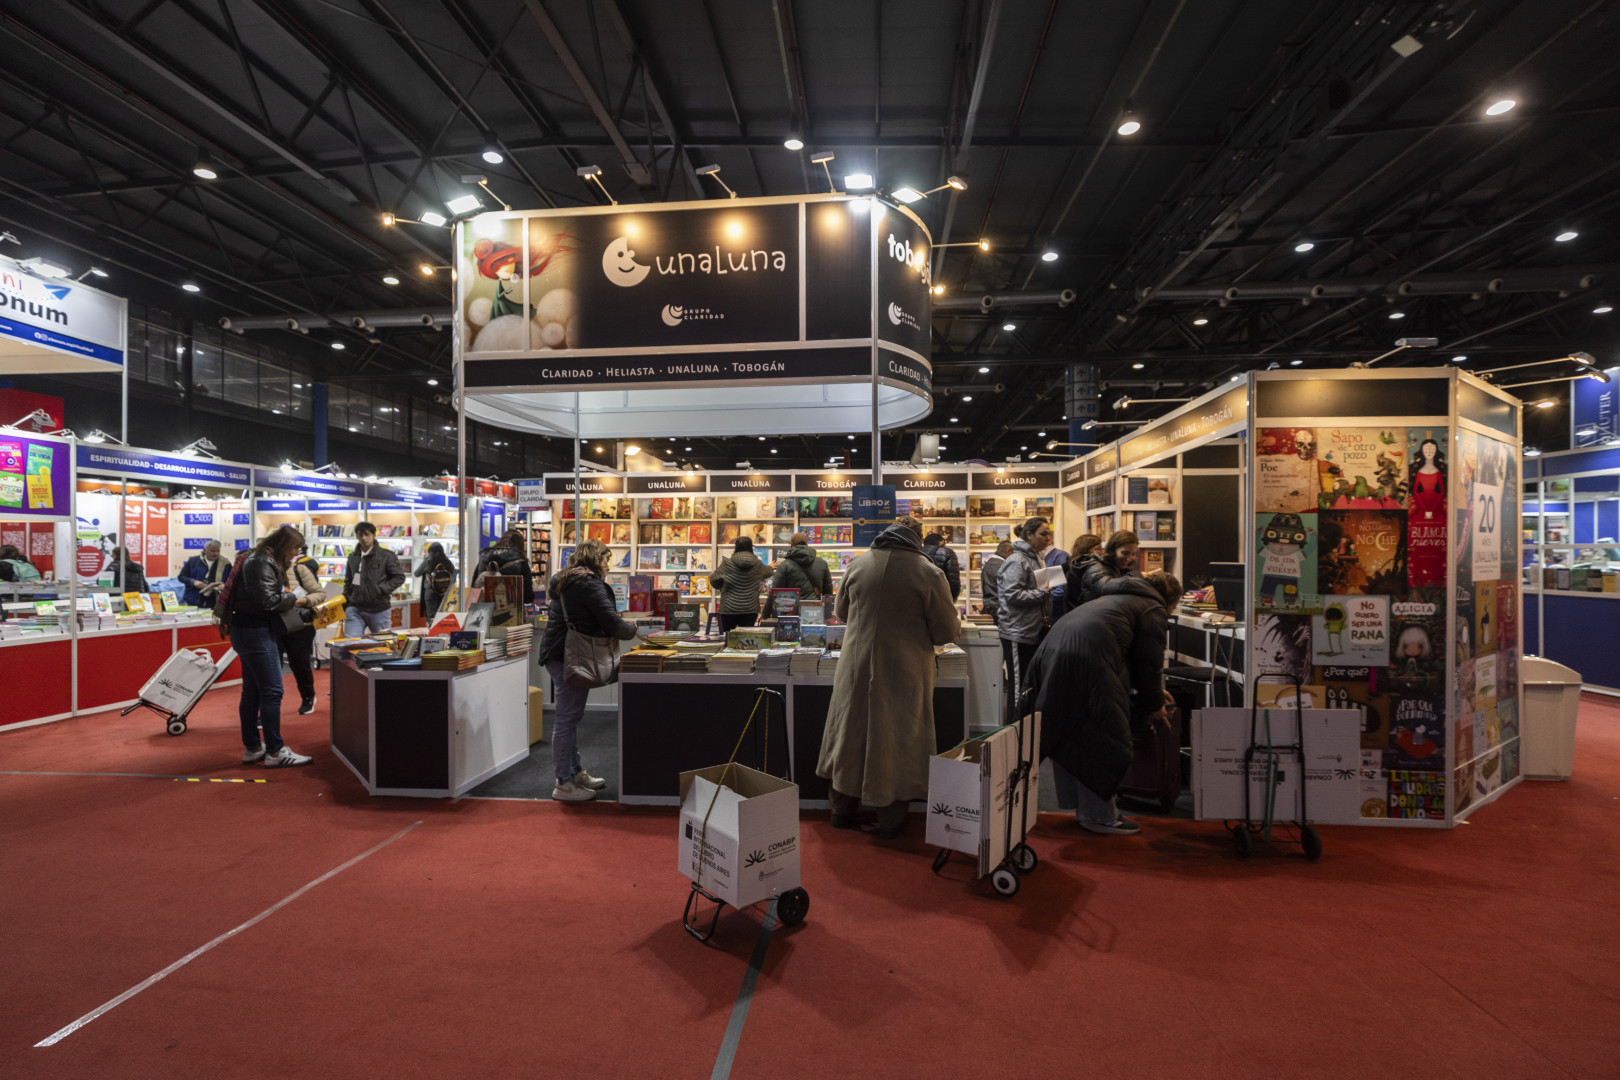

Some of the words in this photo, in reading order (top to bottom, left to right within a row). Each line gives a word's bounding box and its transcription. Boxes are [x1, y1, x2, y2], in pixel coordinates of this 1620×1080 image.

[684, 313, 725, 321] CLARIDAD
[541, 368, 593, 378] CLARIDAD
[605, 365, 655, 377] HELIASTA
[731, 360, 785, 373] TOBOGÁN
[889, 360, 921, 382] CLARIDAD
[1201, 406, 1233, 429] TOBOGÁN
[1331, 431, 1363, 448] Sapo
[1354, 443, 1376, 451] otro
[1343, 451, 1367, 462] pozo
[90, 454, 150, 469] ESPIRITUALIDAD
[154, 463, 196, 475] DESARROLLO
[196, 468, 226, 478] PERSONAL
[229, 472, 247, 480] SALUD
[1261, 463, 1278, 472] Poe
[816, 478, 857, 488] TOBOGÁN
[903, 479, 946, 488] CLARIDAD
[994, 477, 1037, 486] CLARIDAD
[1479, 494, 1495, 533] 20
[1410, 527, 1447, 538] BLANCA
[1410, 538, 1446, 547] nieves
[1267, 566, 1297, 574] VUELTA
[1394, 605, 1433, 613] ALICIA
[1355, 611, 1379, 619] QUIERO
[1351, 620, 1365, 628] SER
[1351, 630, 1384, 640] RANA
[1324, 668, 1345, 677] ¿Por
[1347, 667, 1369, 677] qué?
[1391, 769, 1409, 781] LA
[1391, 794, 1433, 807] DONDE
[955, 805, 979, 816] CONAB
[1392, 807, 1425, 818] VIVO
[767, 837, 796, 852] CONABIP
[700, 847, 715, 860] IBRO
[692, 850, 699, 858] DE
[699, 854, 717, 870] UENOS
[716, 865, 730, 878] AIRES
